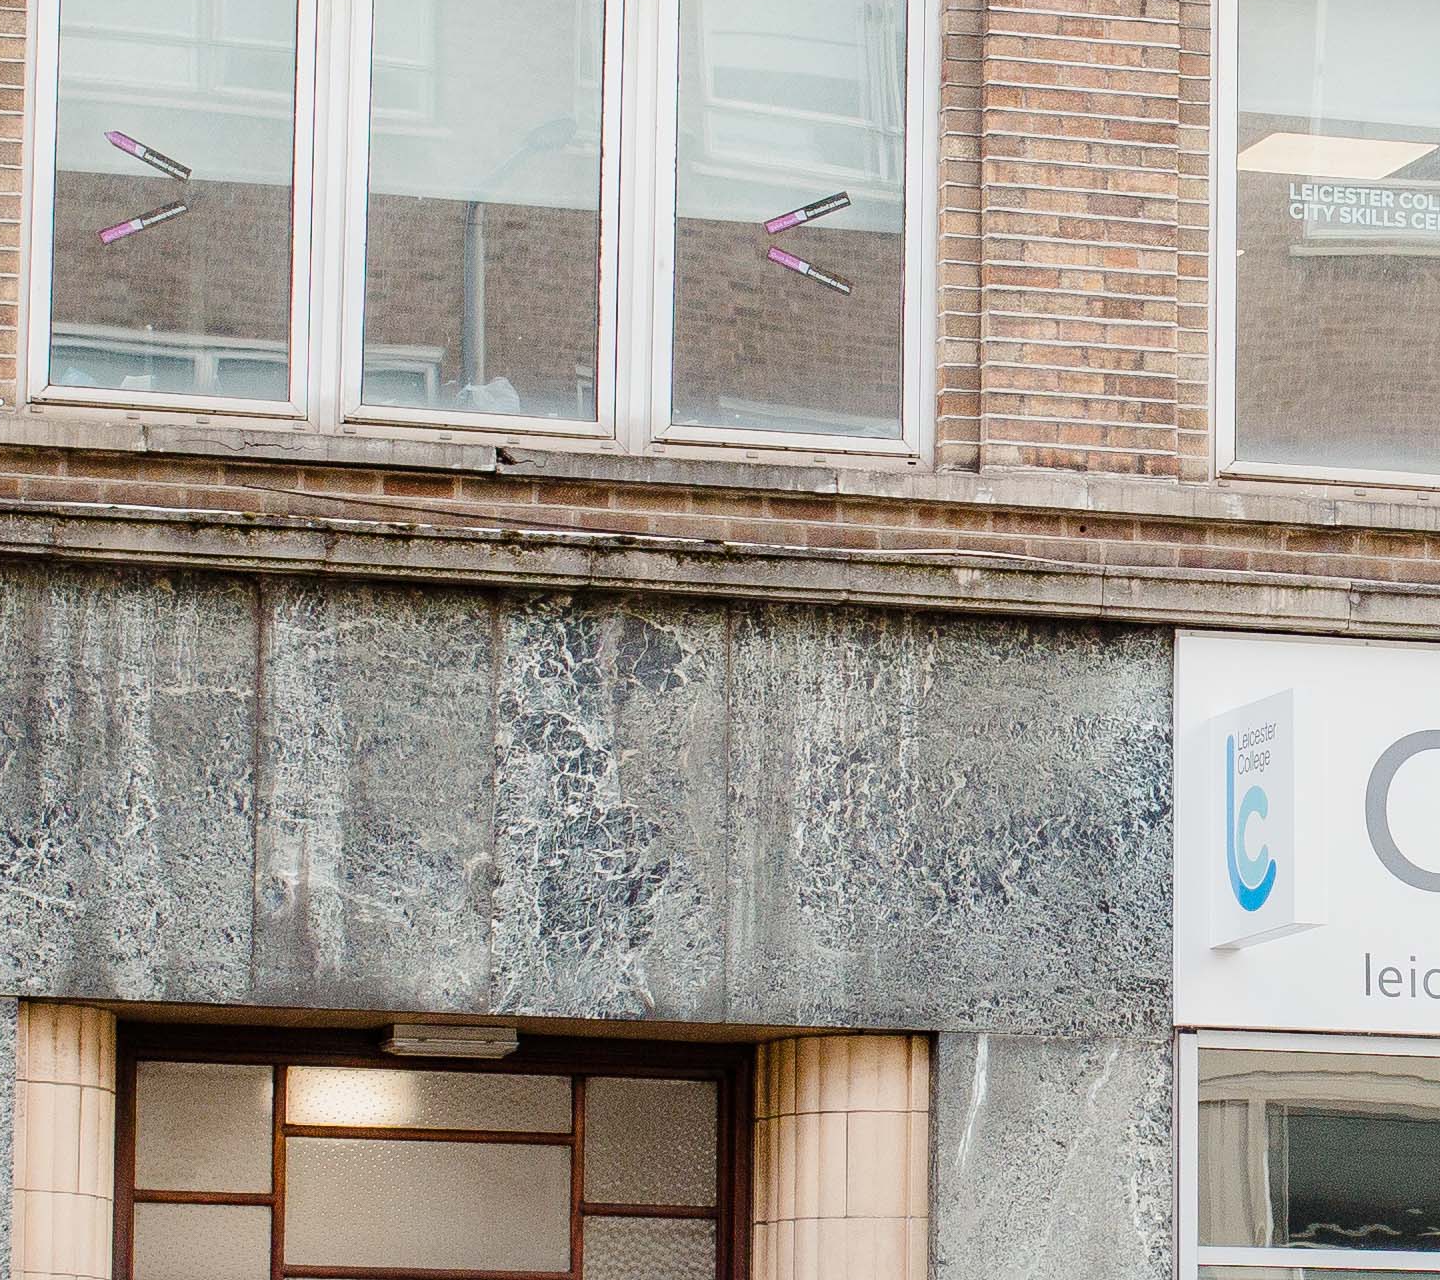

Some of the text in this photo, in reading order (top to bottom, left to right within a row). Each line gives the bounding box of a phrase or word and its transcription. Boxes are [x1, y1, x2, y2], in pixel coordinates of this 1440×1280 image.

[1289, 183, 1394, 208] LEICESTER
[1289, 203, 1336, 222] CITY
[1339, 207, 1407, 228] SKILLS
[1237, 721, 1277, 752] Leicester
[1237, 747, 1271, 776] College
